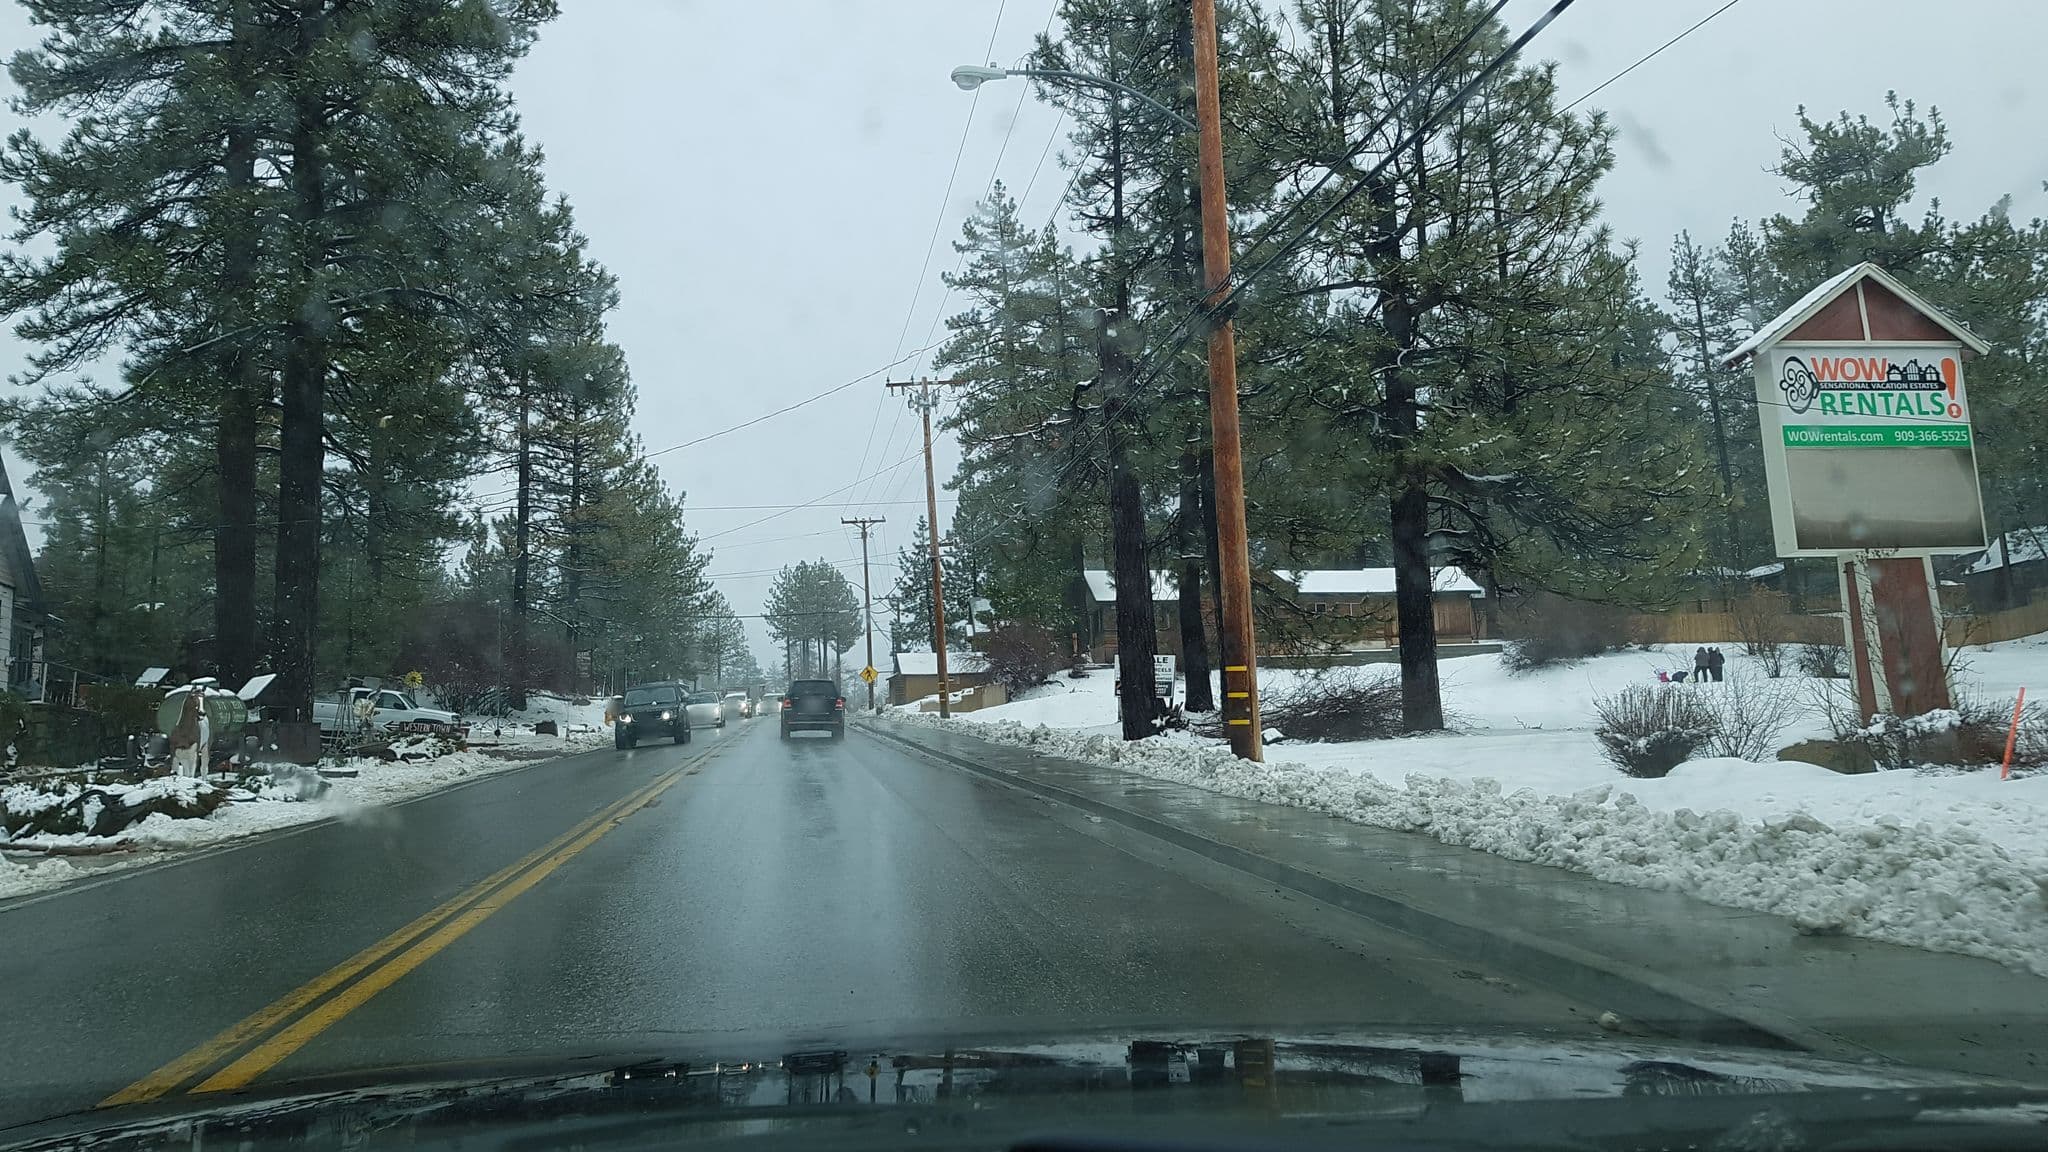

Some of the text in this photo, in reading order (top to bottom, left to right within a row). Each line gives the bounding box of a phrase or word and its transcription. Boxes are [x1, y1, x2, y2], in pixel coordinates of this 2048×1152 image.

[1811, 357, 1887, 381] WOW
[1819, 382, 1939, 390] SENSATIONAL VACATION ESTATES
[1787, 430, 1968, 442] WOWrentals.com 909-366-5525
[403, 722, 452, 733] WESTERN TOWN
